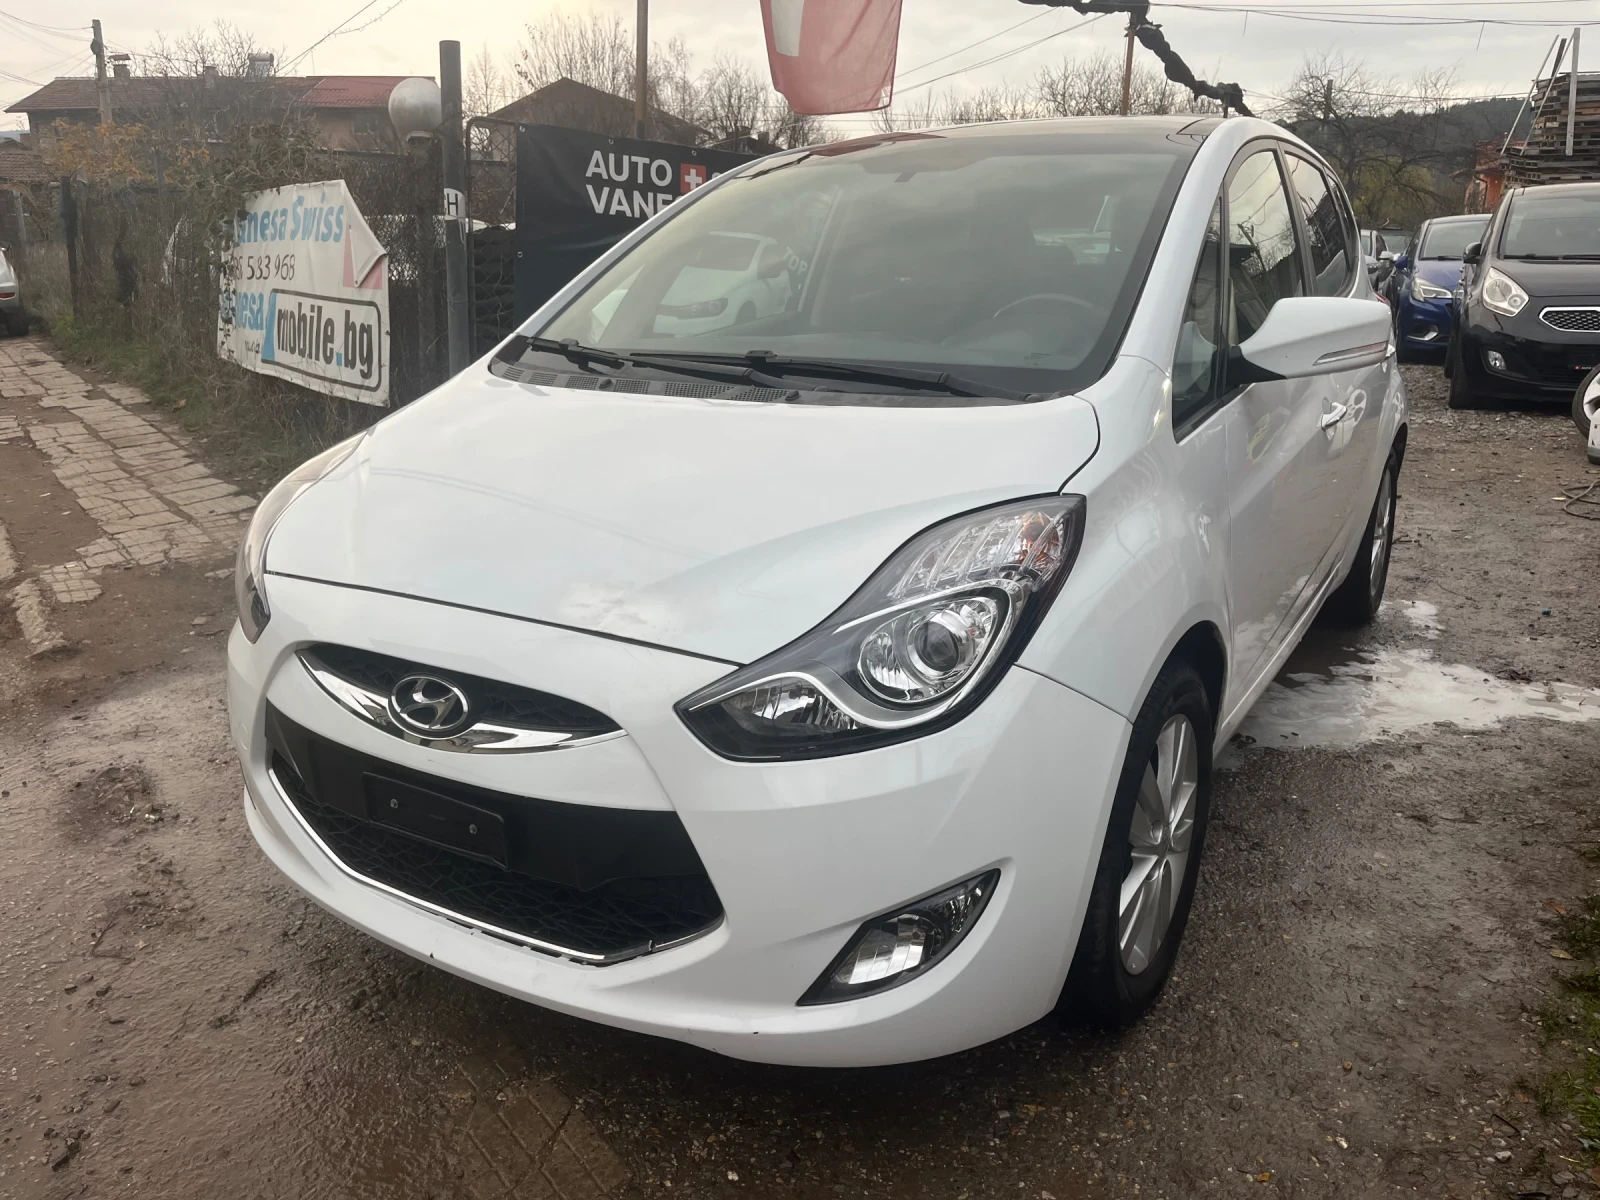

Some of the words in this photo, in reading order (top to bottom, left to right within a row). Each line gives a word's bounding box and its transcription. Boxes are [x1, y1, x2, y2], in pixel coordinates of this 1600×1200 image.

[585, 150, 673, 187] AUTO
[290, 191, 345, 244] Swiss
[586, 184, 683, 219] VANE
[247, 255, 271, 280] 583
[274, 253, 296, 281] 968
[277, 302, 374, 380] mobile.bg
